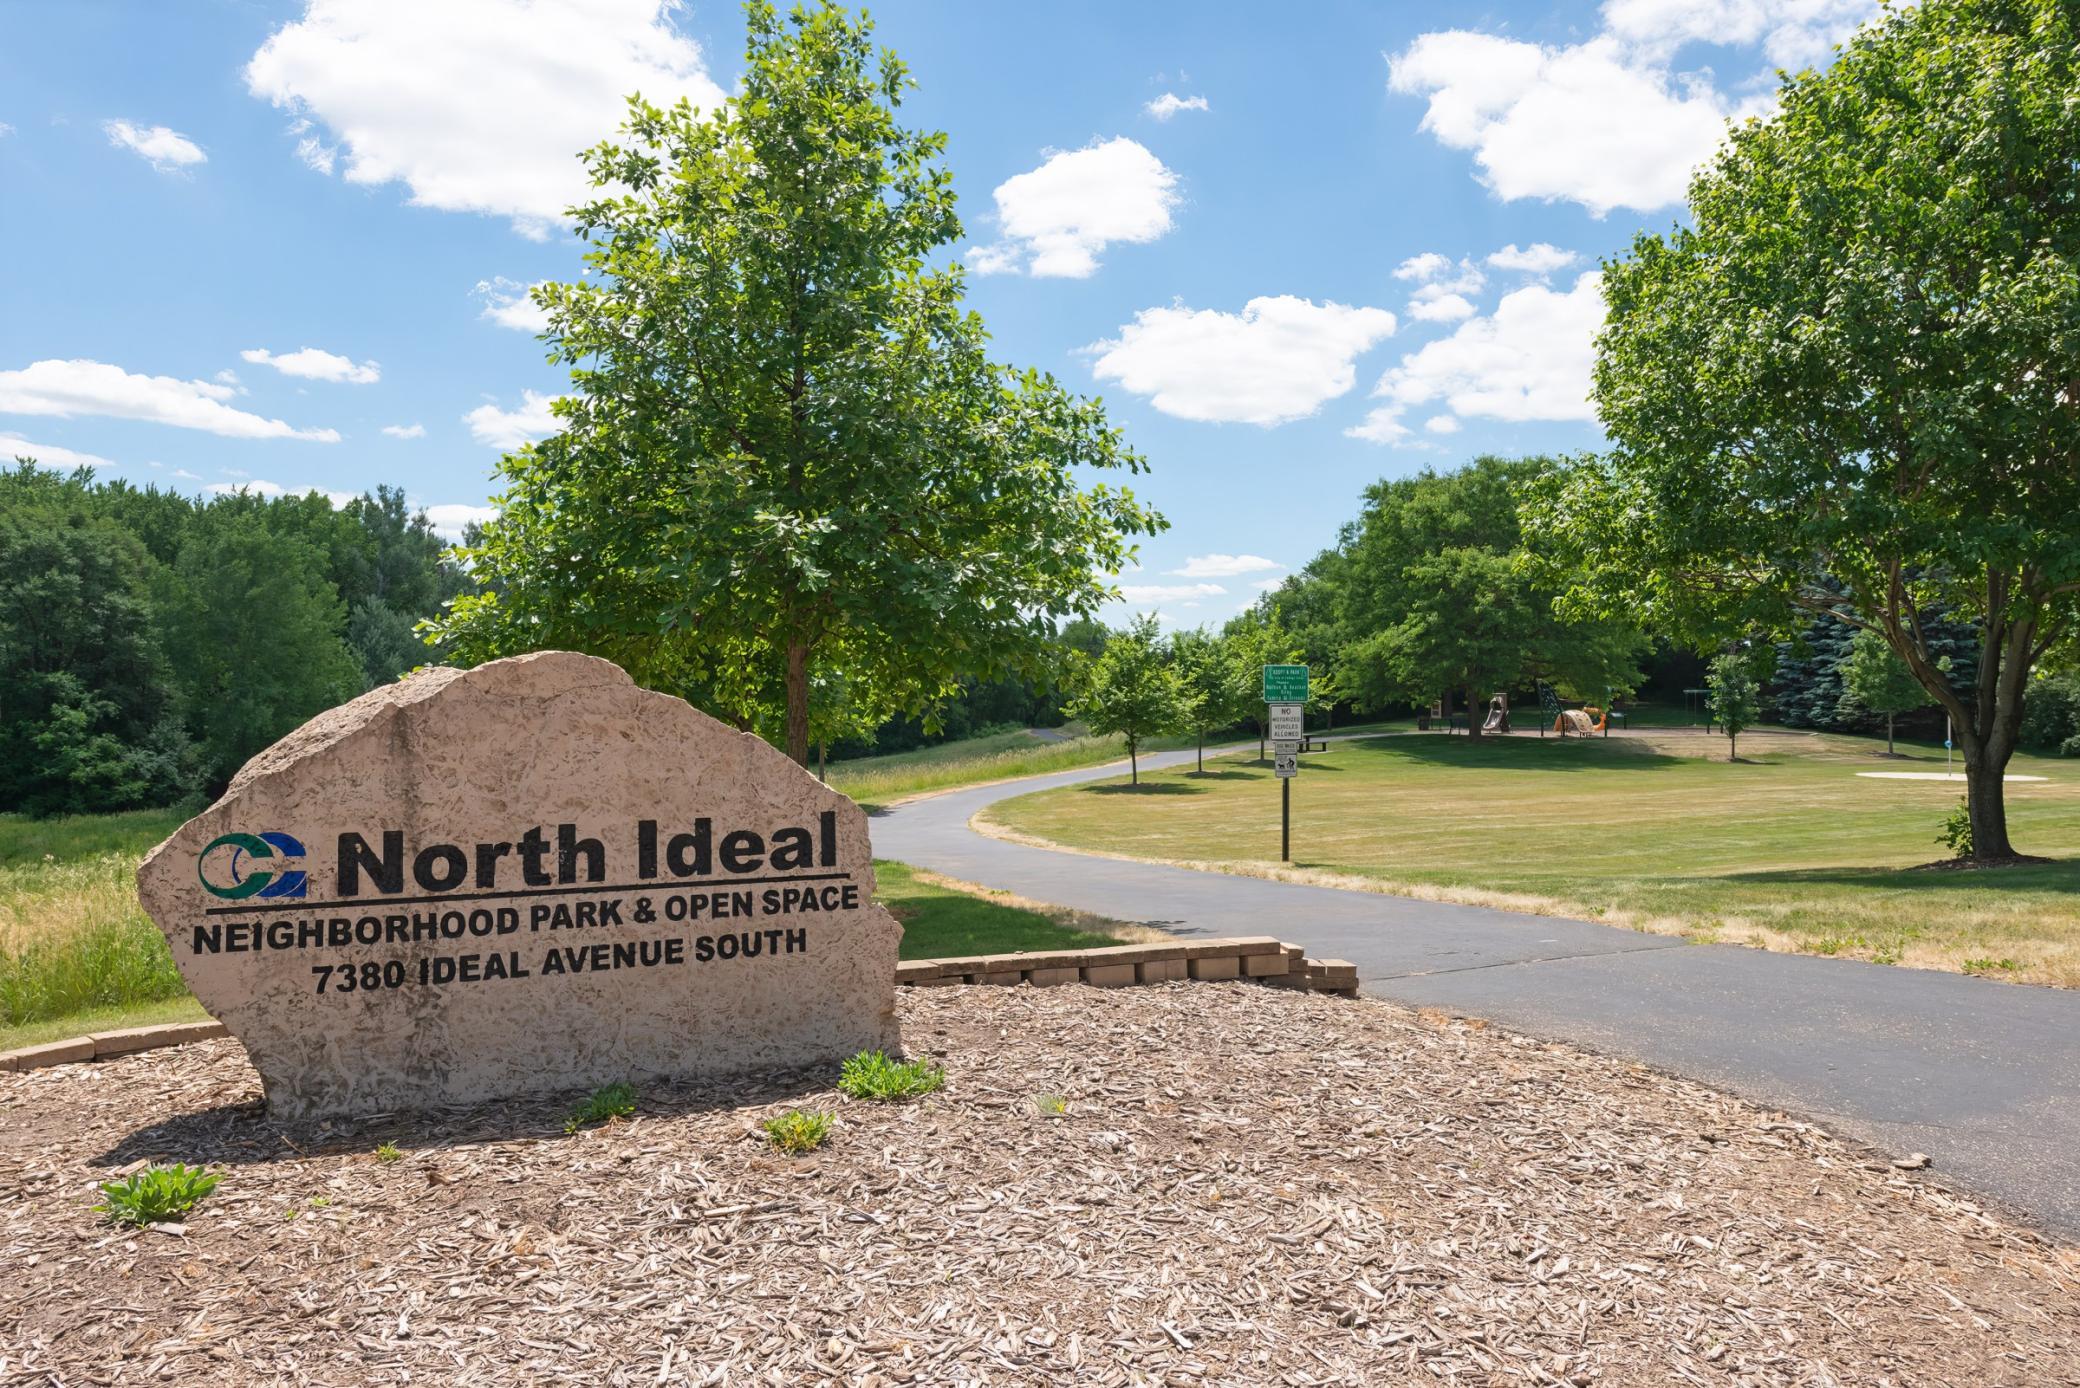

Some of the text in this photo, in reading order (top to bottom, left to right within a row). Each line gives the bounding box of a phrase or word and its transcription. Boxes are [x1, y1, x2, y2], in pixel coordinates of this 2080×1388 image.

[337, 810, 837, 897] North Ideal
[193, 885, 859, 955] NEIGHBORHOOD PARK & OPEN SPACE
[311, 928, 807, 995] 7380 IDEAL AVENUE SOUTH
